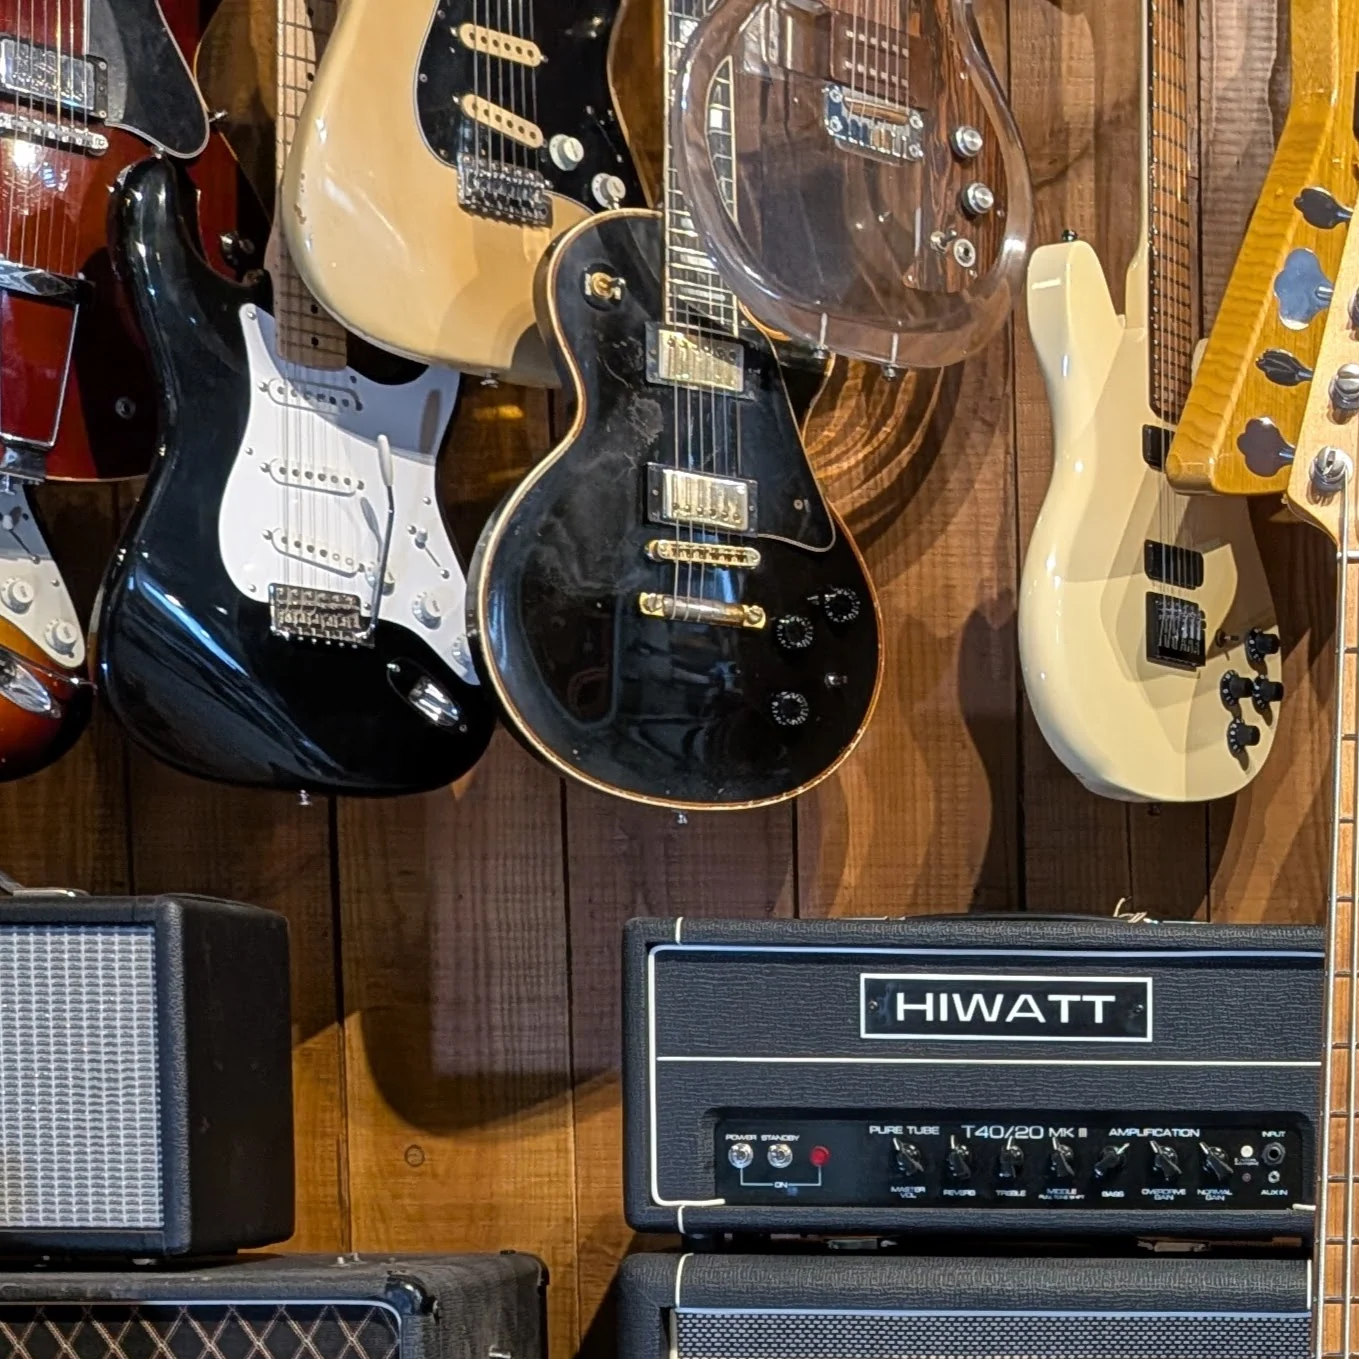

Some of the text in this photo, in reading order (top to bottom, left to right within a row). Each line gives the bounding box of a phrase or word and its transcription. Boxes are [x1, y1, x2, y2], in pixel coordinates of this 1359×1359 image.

[896, 992, 1116, 1023] HIWATT
[869, 1126, 940, 1135] PURE TUBE
[961, 1125, 1044, 1140] T40/20
[1048, 1127, 1075, 1138] MK
[1108, 1128, 1200, 1138] AMPLIFICATION
[761, 1134, 800, 1142] STANDBY
[773, 1181, 788, 1189] ON
[1101, 1190, 1125, 1198] BASS
